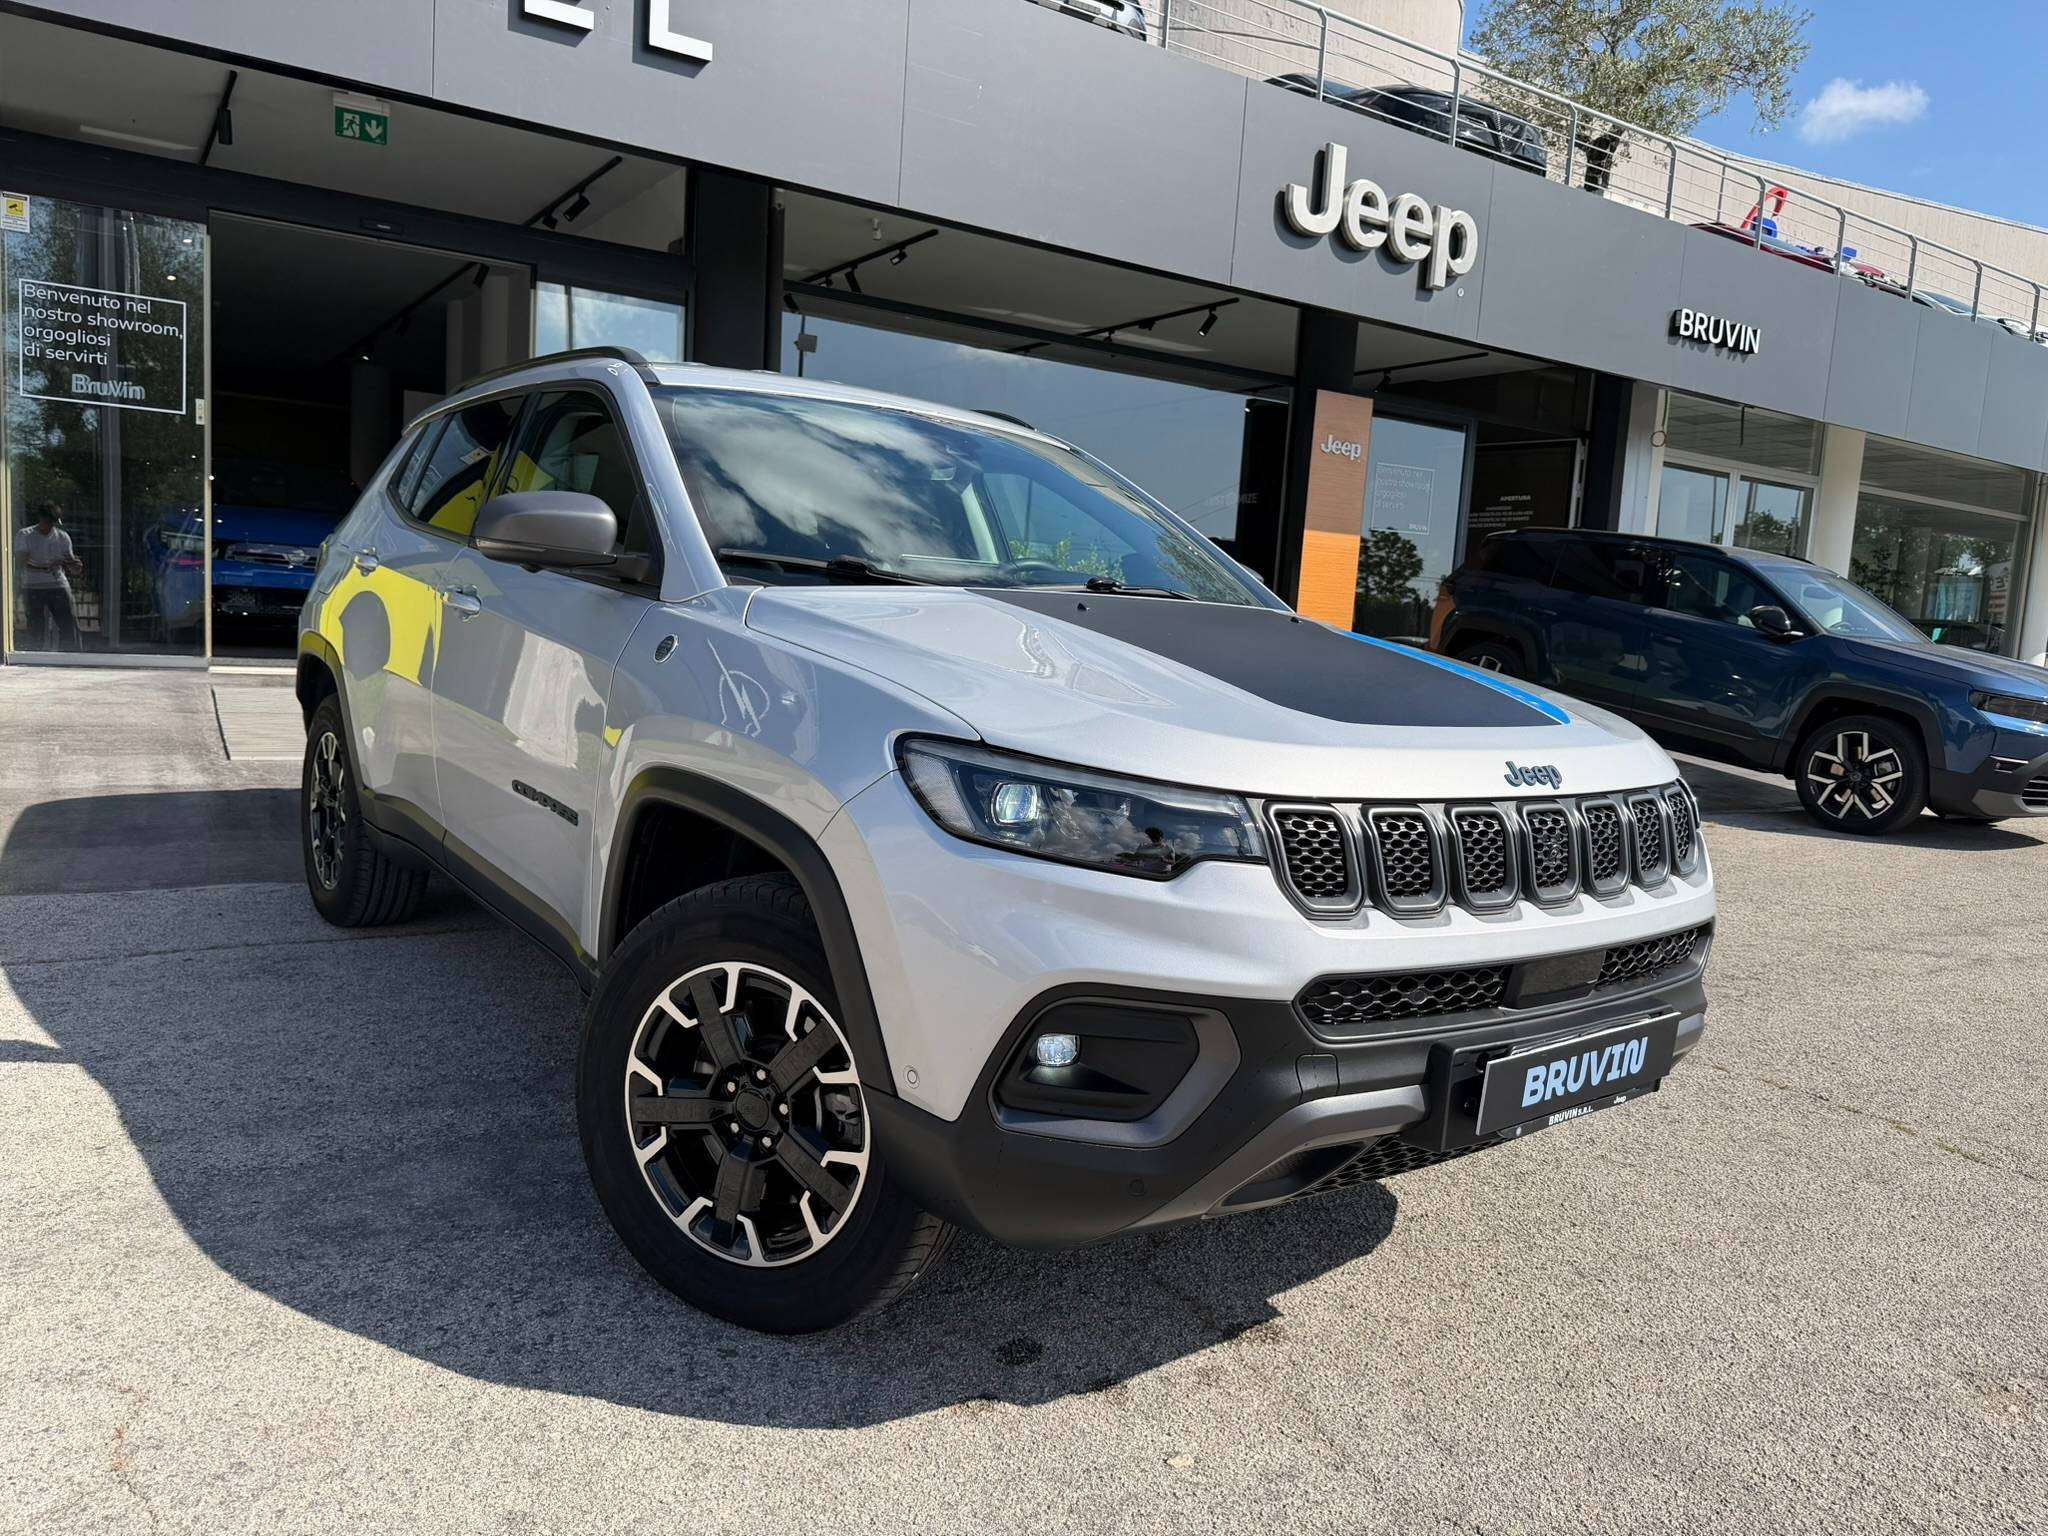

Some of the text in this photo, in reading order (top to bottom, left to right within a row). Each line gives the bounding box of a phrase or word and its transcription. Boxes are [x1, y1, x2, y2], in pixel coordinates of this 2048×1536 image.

[1285, 142, 1479, 290] Jeep
[23, 284, 151, 314] Benvenuto nel
[24, 306, 184, 340] nostro showroom,
[24, 327, 111, 346] orgogliosi
[1680, 308, 1760, 354] BRUVIN
[24, 344, 108, 365] di servirti
[1320, 434, 1361, 460] Jeep
[1504, 760, 1562, 790] Jeep
[1521, 1037, 1648, 1108] BRUVIN
[1548, 1107, 1578, 1126] BRUVIN
